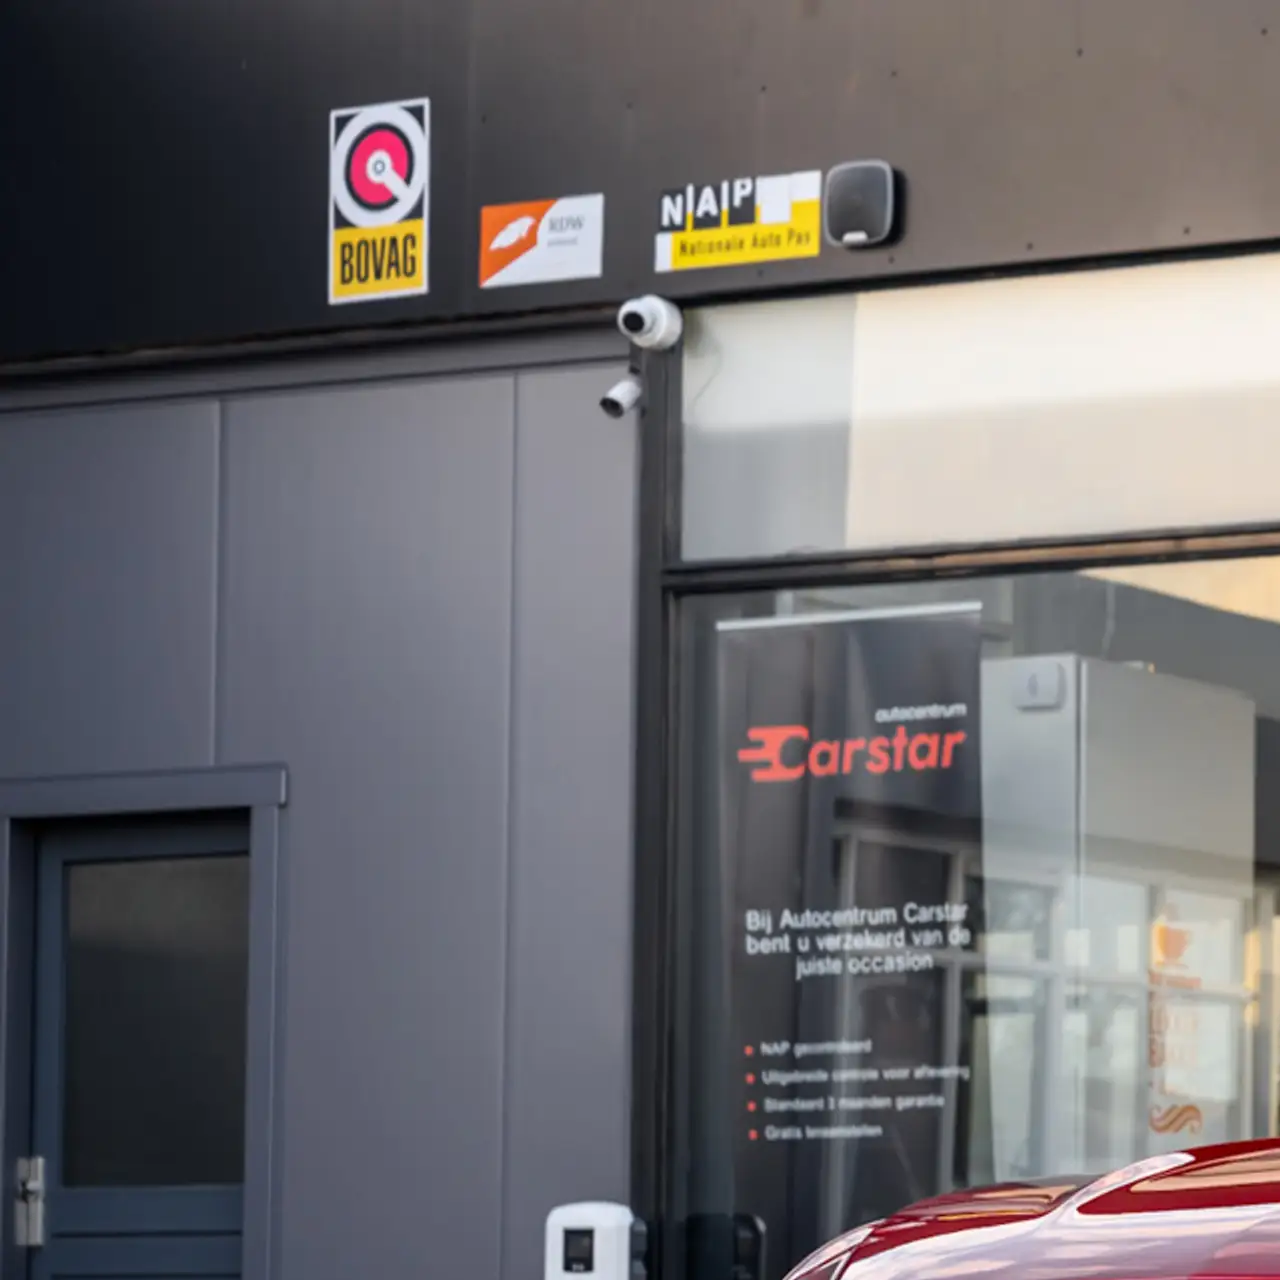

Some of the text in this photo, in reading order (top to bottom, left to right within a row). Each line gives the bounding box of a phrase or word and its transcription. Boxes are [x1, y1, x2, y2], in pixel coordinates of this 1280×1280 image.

[661, 177, 753, 227] NAP
[340, 233, 417, 286] BOVAG
[679, 237, 745, 257] Nationale
[752, 232, 782, 249] Auto
[875, 703, 967, 723] autocentrum
[737, 725, 967, 782] Carstar
[745, 902, 968, 934] Bij Autocentrum Carstar
[745, 924, 971, 954] bent u verzekerd van de
[796, 952, 934, 980] juiste occasion
